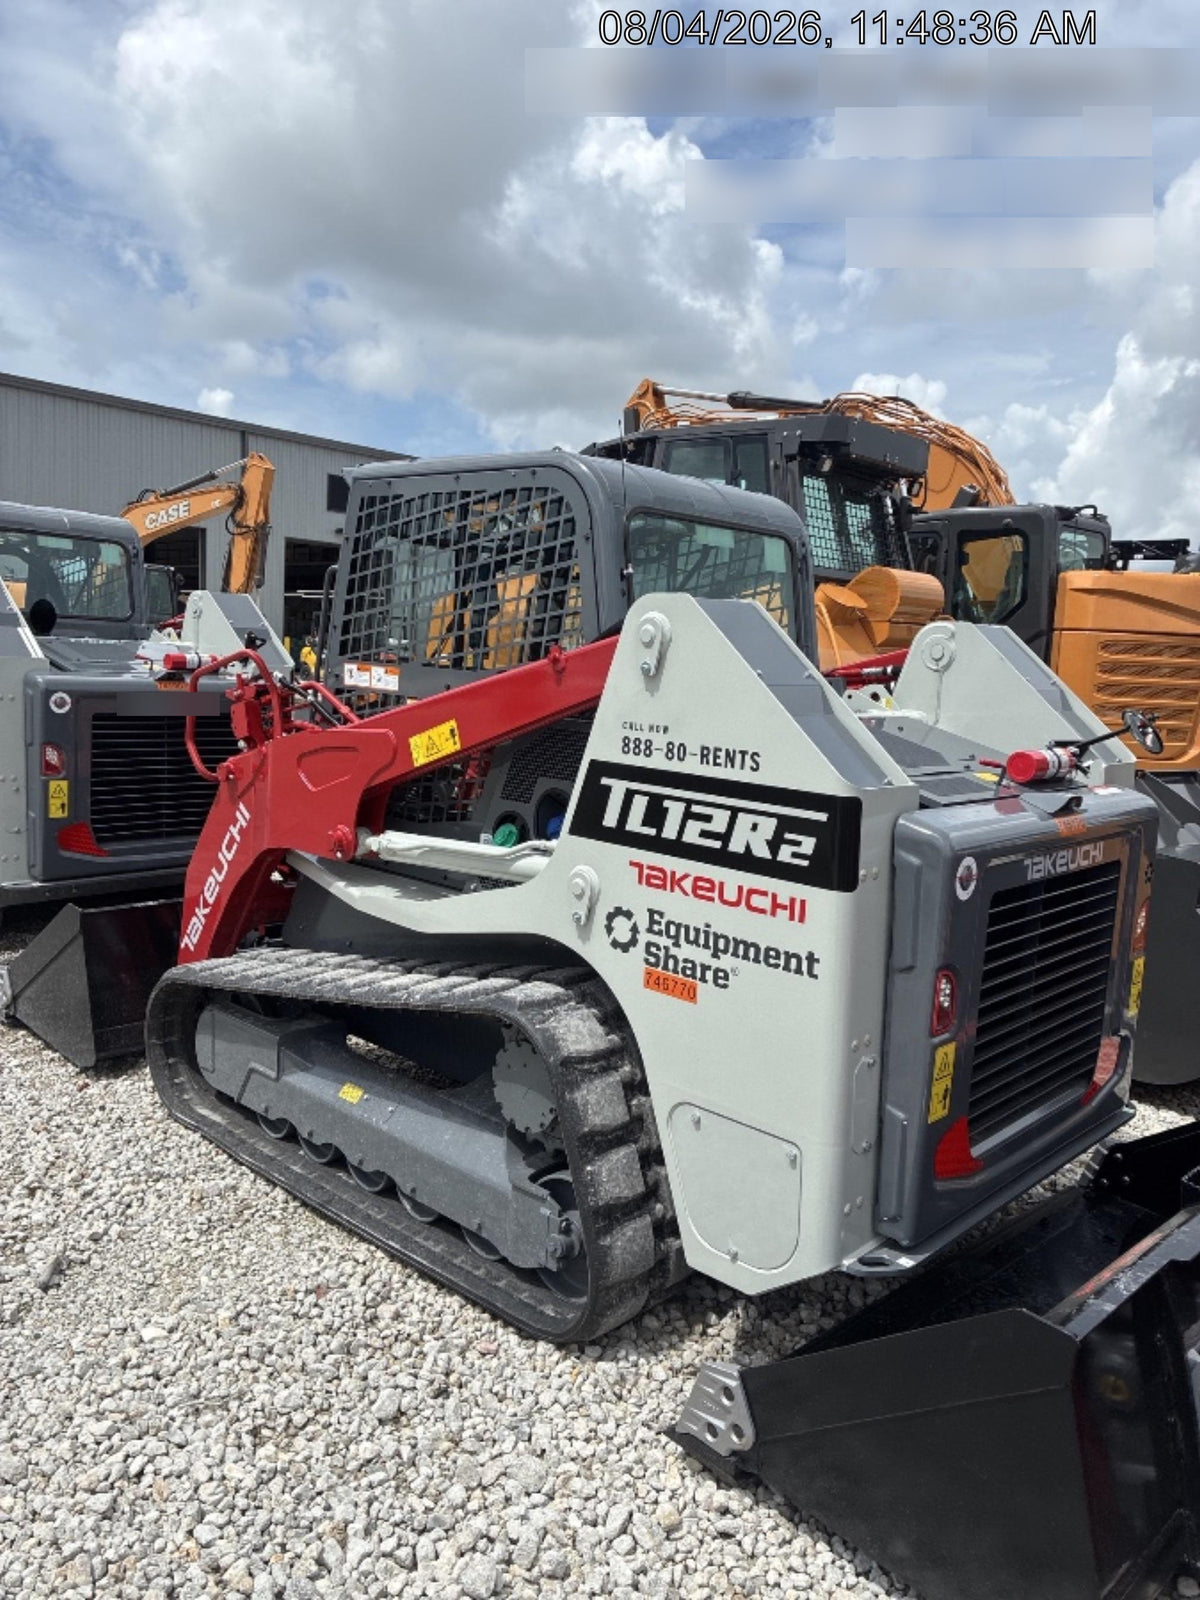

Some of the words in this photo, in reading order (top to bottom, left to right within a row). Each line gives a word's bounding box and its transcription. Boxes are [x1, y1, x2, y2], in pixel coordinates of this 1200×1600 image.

[144, 499, 190, 530] CASE
[621, 735, 761, 773] 888-80-RENTS
[600, 776, 829, 867] TL12R2
[645, 907, 821, 980] Equipment
[645, 972, 697, 1001] 746770
